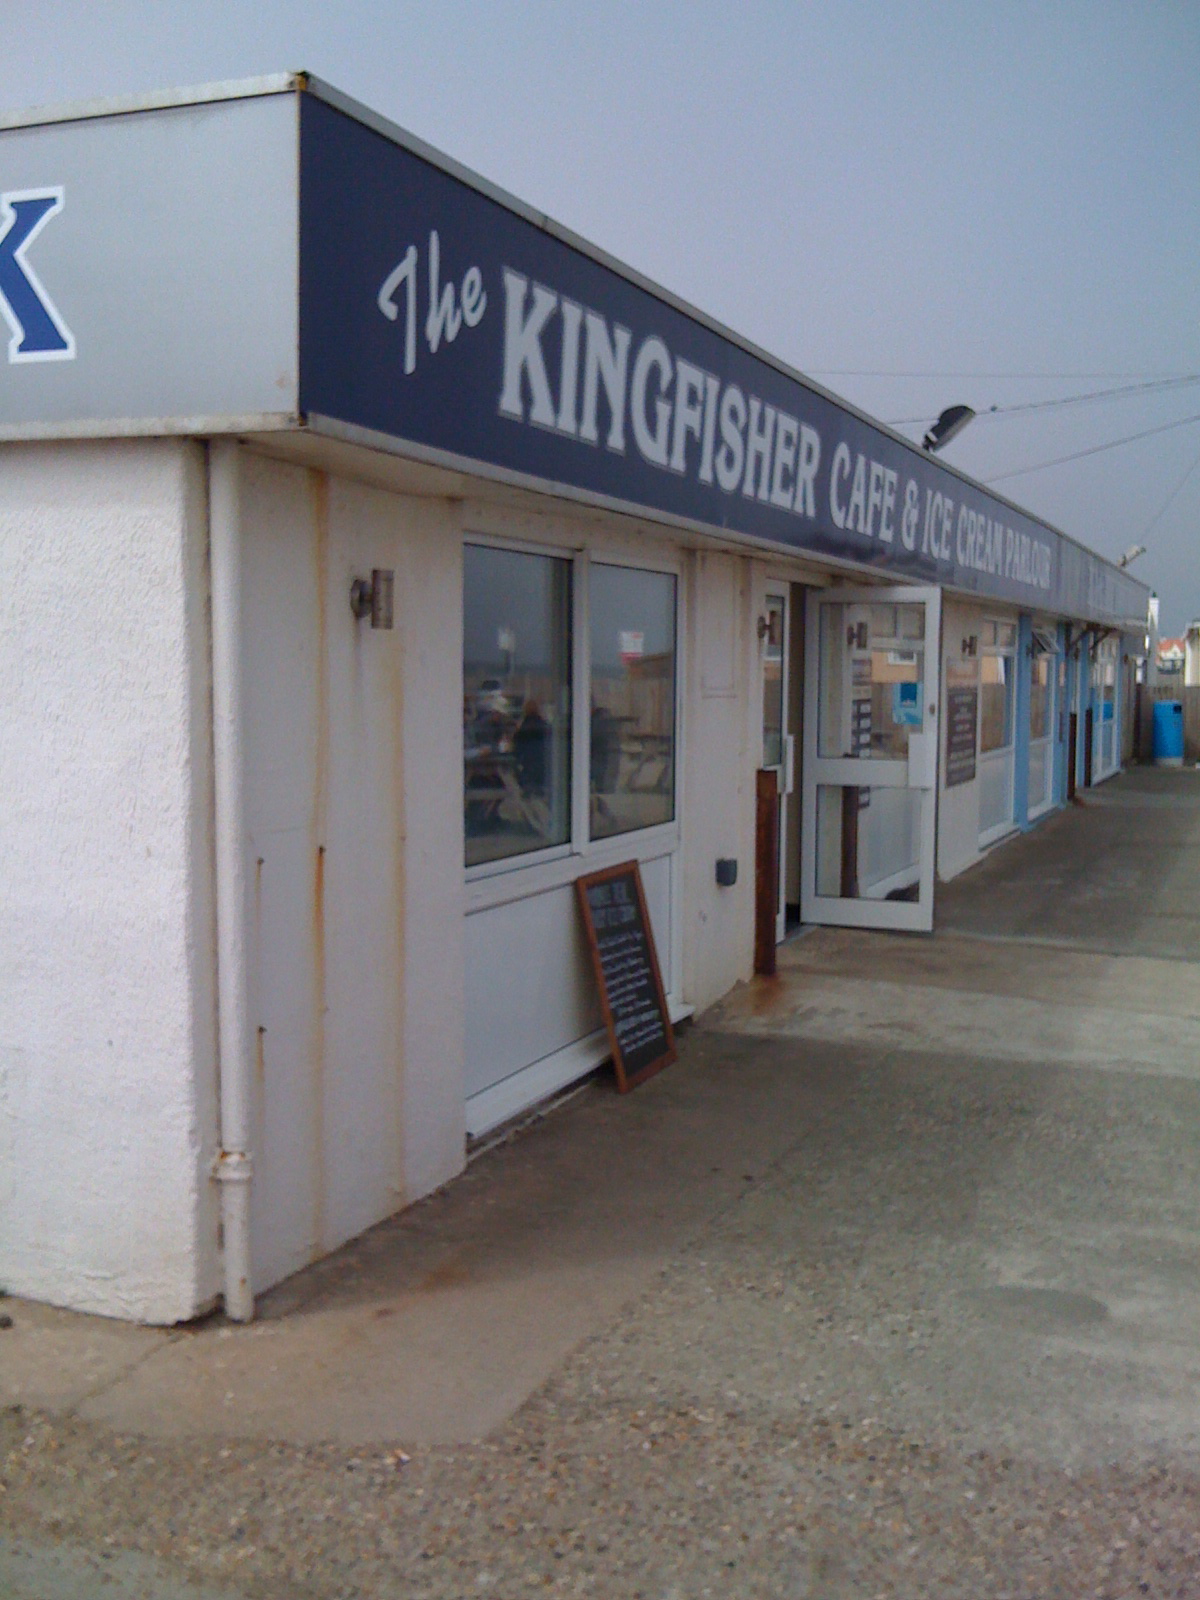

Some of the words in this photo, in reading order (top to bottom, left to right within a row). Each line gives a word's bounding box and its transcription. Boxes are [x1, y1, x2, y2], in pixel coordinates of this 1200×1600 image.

[378, 229, 487, 375] The
[498, 266, 822, 520] KINGFISHER
[829, 442, 898, 543] CAFE
[901, 479, 918, 551] &
[922, 487, 954, 562] ICE
[956, 503, 1003, 576] CREAM
